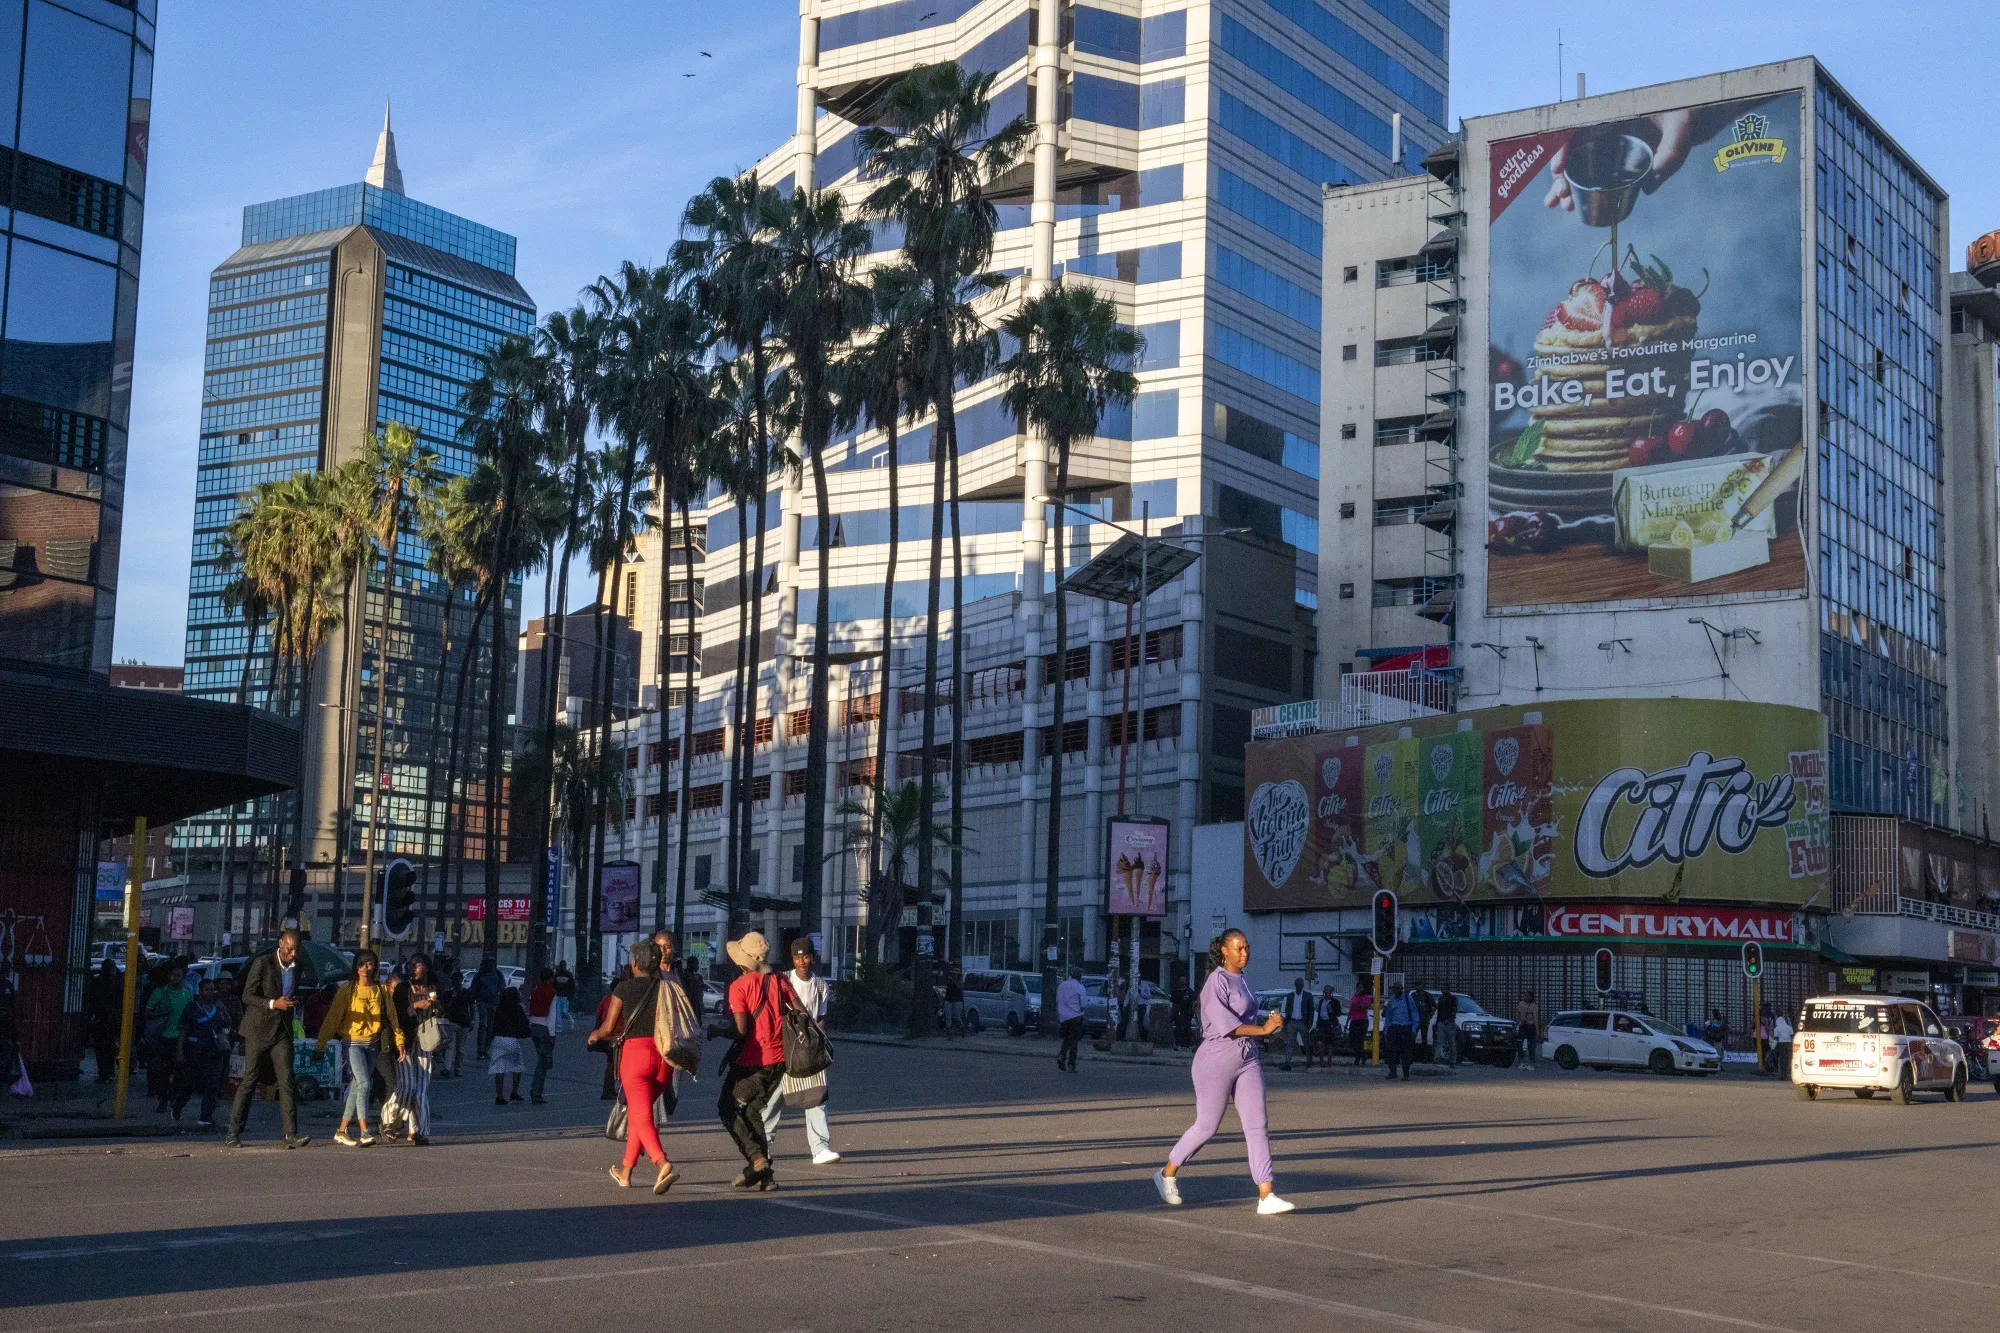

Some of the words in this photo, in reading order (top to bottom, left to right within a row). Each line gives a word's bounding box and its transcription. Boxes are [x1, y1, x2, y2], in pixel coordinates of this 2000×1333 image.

[1500, 149, 1526, 178] extra
[1726, 142, 1774, 157] OLIVINE
[1498, 145, 1544, 198] goodness
[1527, 349, 1608, 369] Zimbabwe's
[1612, 341, 1677, 360] Favourite
[1682, 333, 1757, 352] Margarine
[1495, 375, 1593, 411] Bake,
[1606, 367, 1676, 399] Eat,
[1690, 352, 1794, 393] Enjoy
[1639, 481, 1715, 502] Buttercup
[1641, 497, 1724, 520] Margarine
[1253, 706, 1277, 728] CALL
[1280, 701, 1318, 723] CENTRE
[1255, 724, 1291, 736] RESTAURANT
[1424, 787, 1459, 815] Citro
[1487, 780, 1526, 810] Citro
[1805, 780, 1825, 809] Joy
[1250, 796, 1306, 840] Victoria
[1574, 751, 1785, 879] Citro
[1258, 822, 1304, 869] Fruit
[516, 899, 526, 908] TO
[547, 864, 555, 923] PHARMACY
[1843, 967, 1875, 976] CELLPHONE
[1845, 975, 1872, 984] REPAIRS
[1813, 1011, 1832, 1019] 0772
[1833, 1011, 1848, 1019] 777
[1850, 1011, 1865, 1020] 115
[1804, 1039, 1815, 1050] 06
